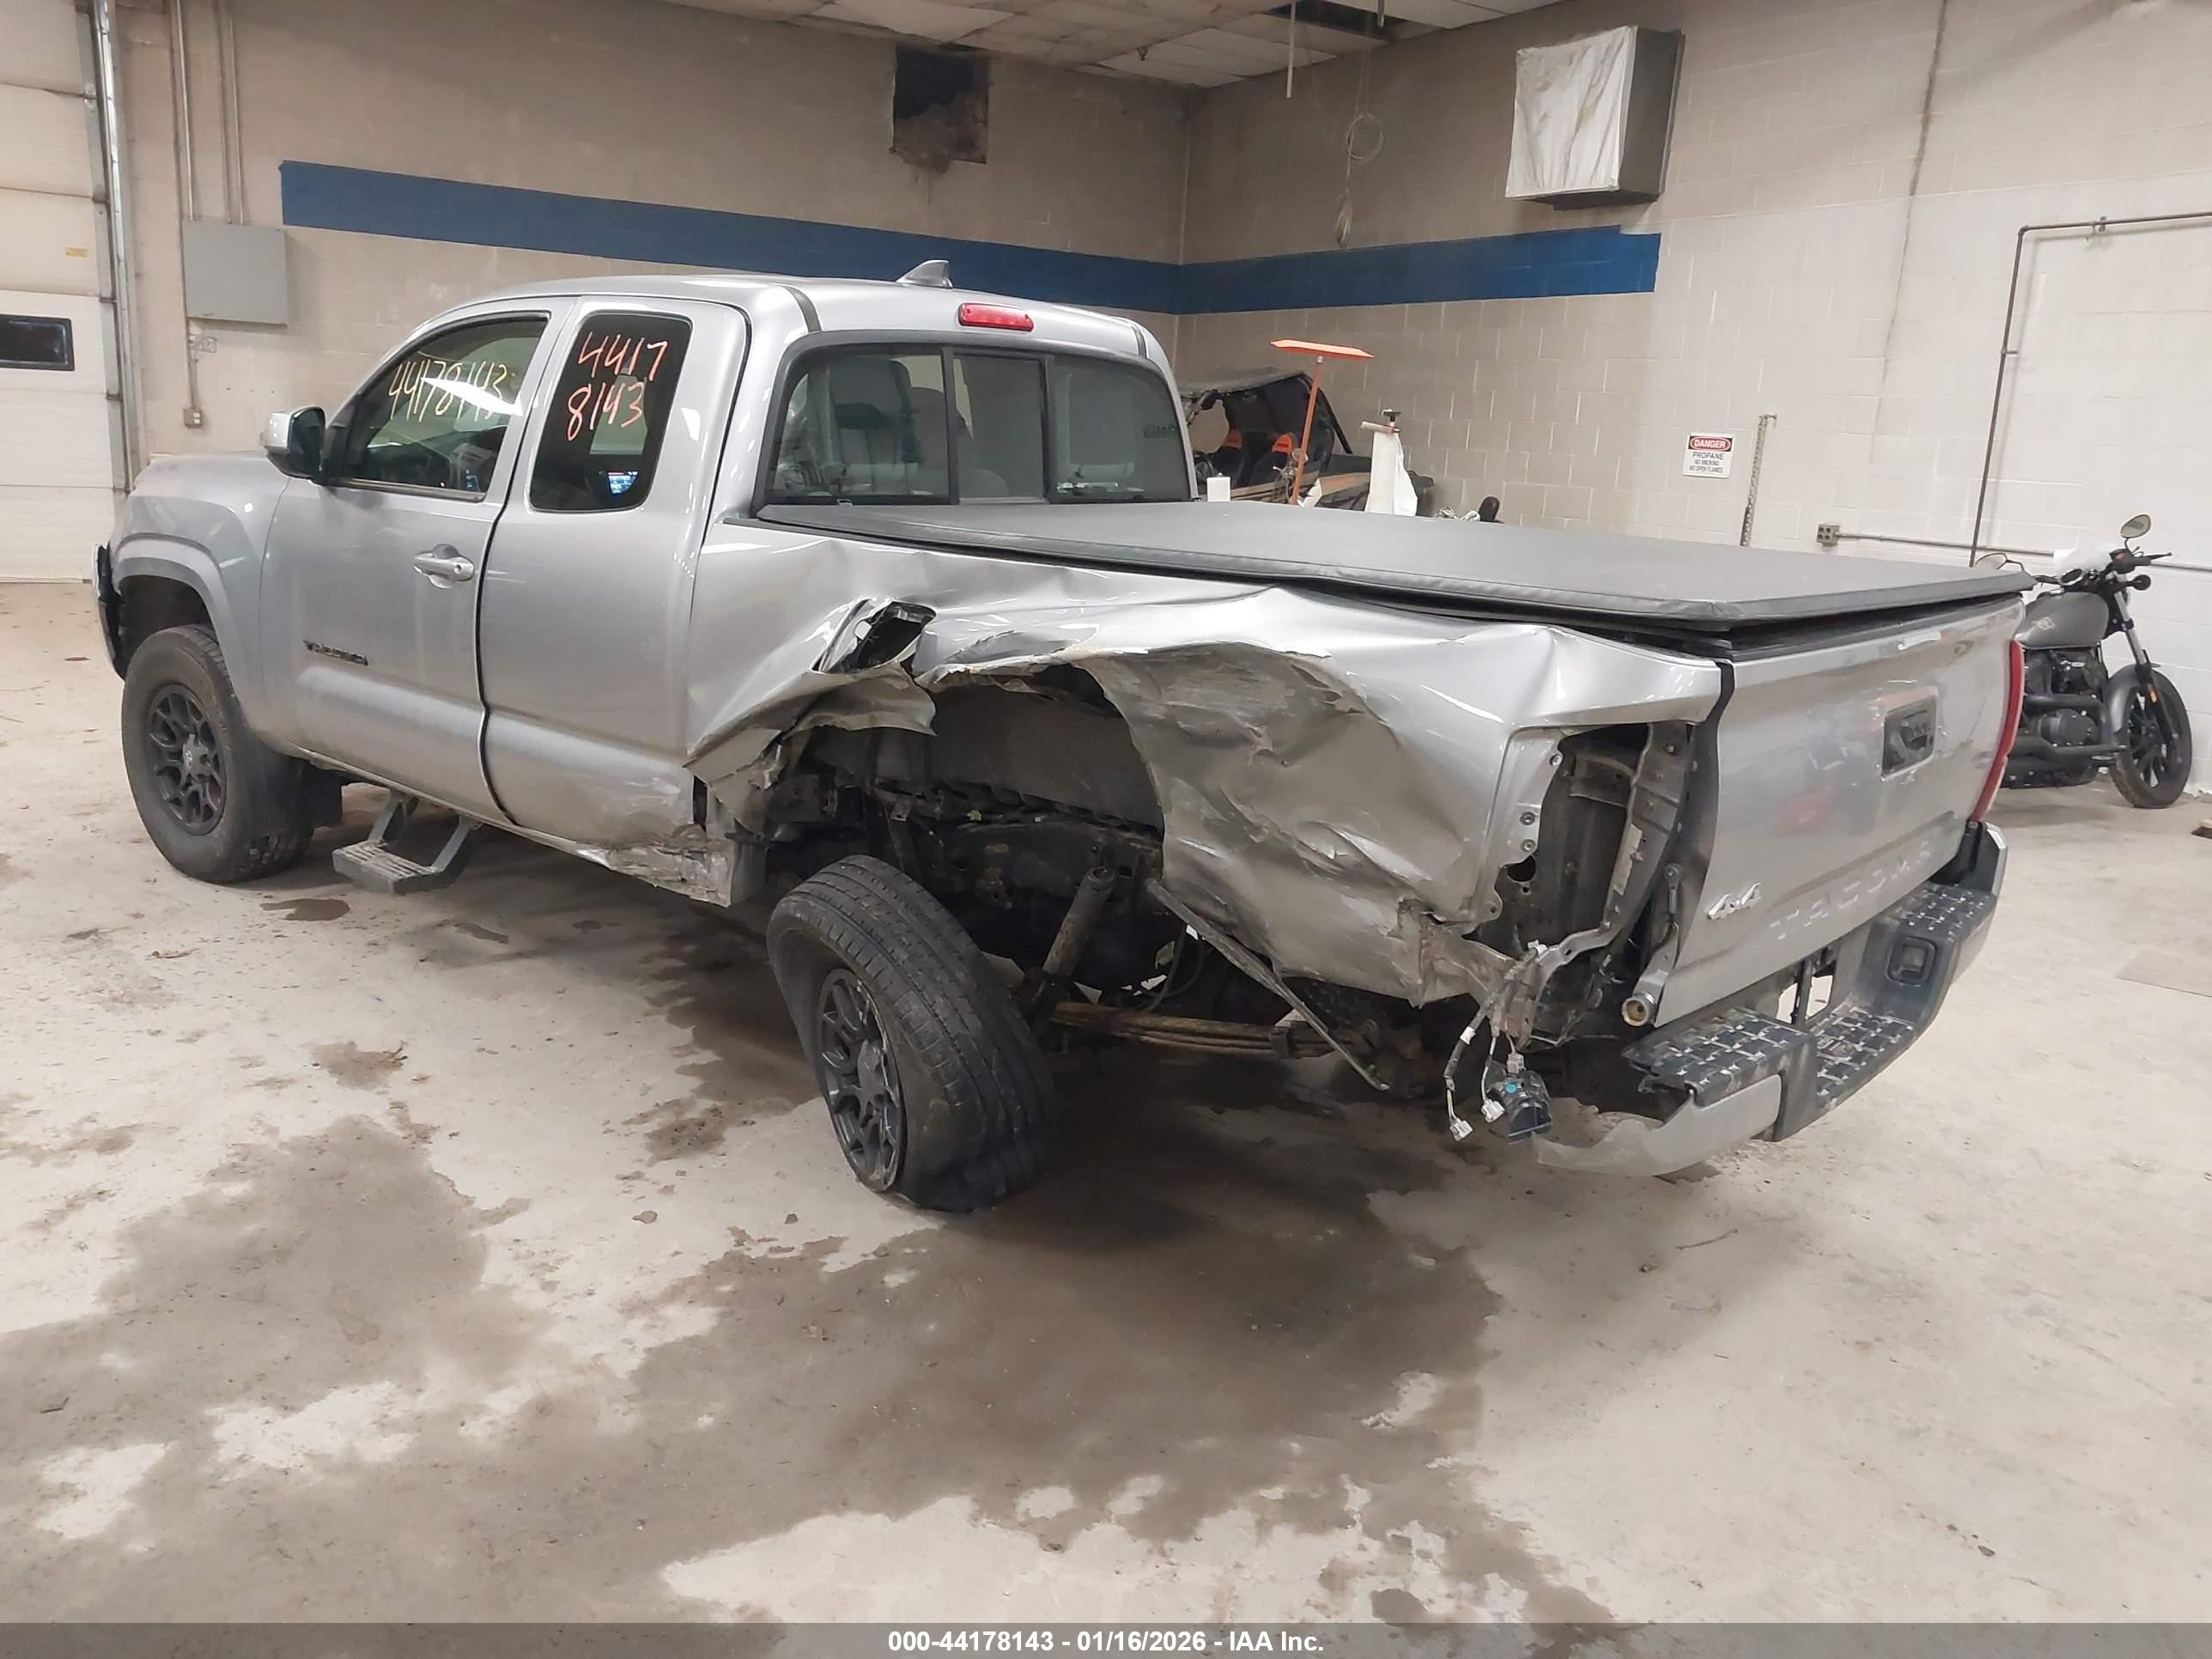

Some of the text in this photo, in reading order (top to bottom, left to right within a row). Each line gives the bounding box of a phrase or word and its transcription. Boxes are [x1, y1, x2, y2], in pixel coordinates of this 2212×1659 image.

[577, 331, 669, 381] 4417
[389, 359, 508, 422] 44178143
[567, 382, 646, 441] 8143
[1692, 452, 1725, 460] PROPANE
[1694, 439, 1726, 448] DANGER
